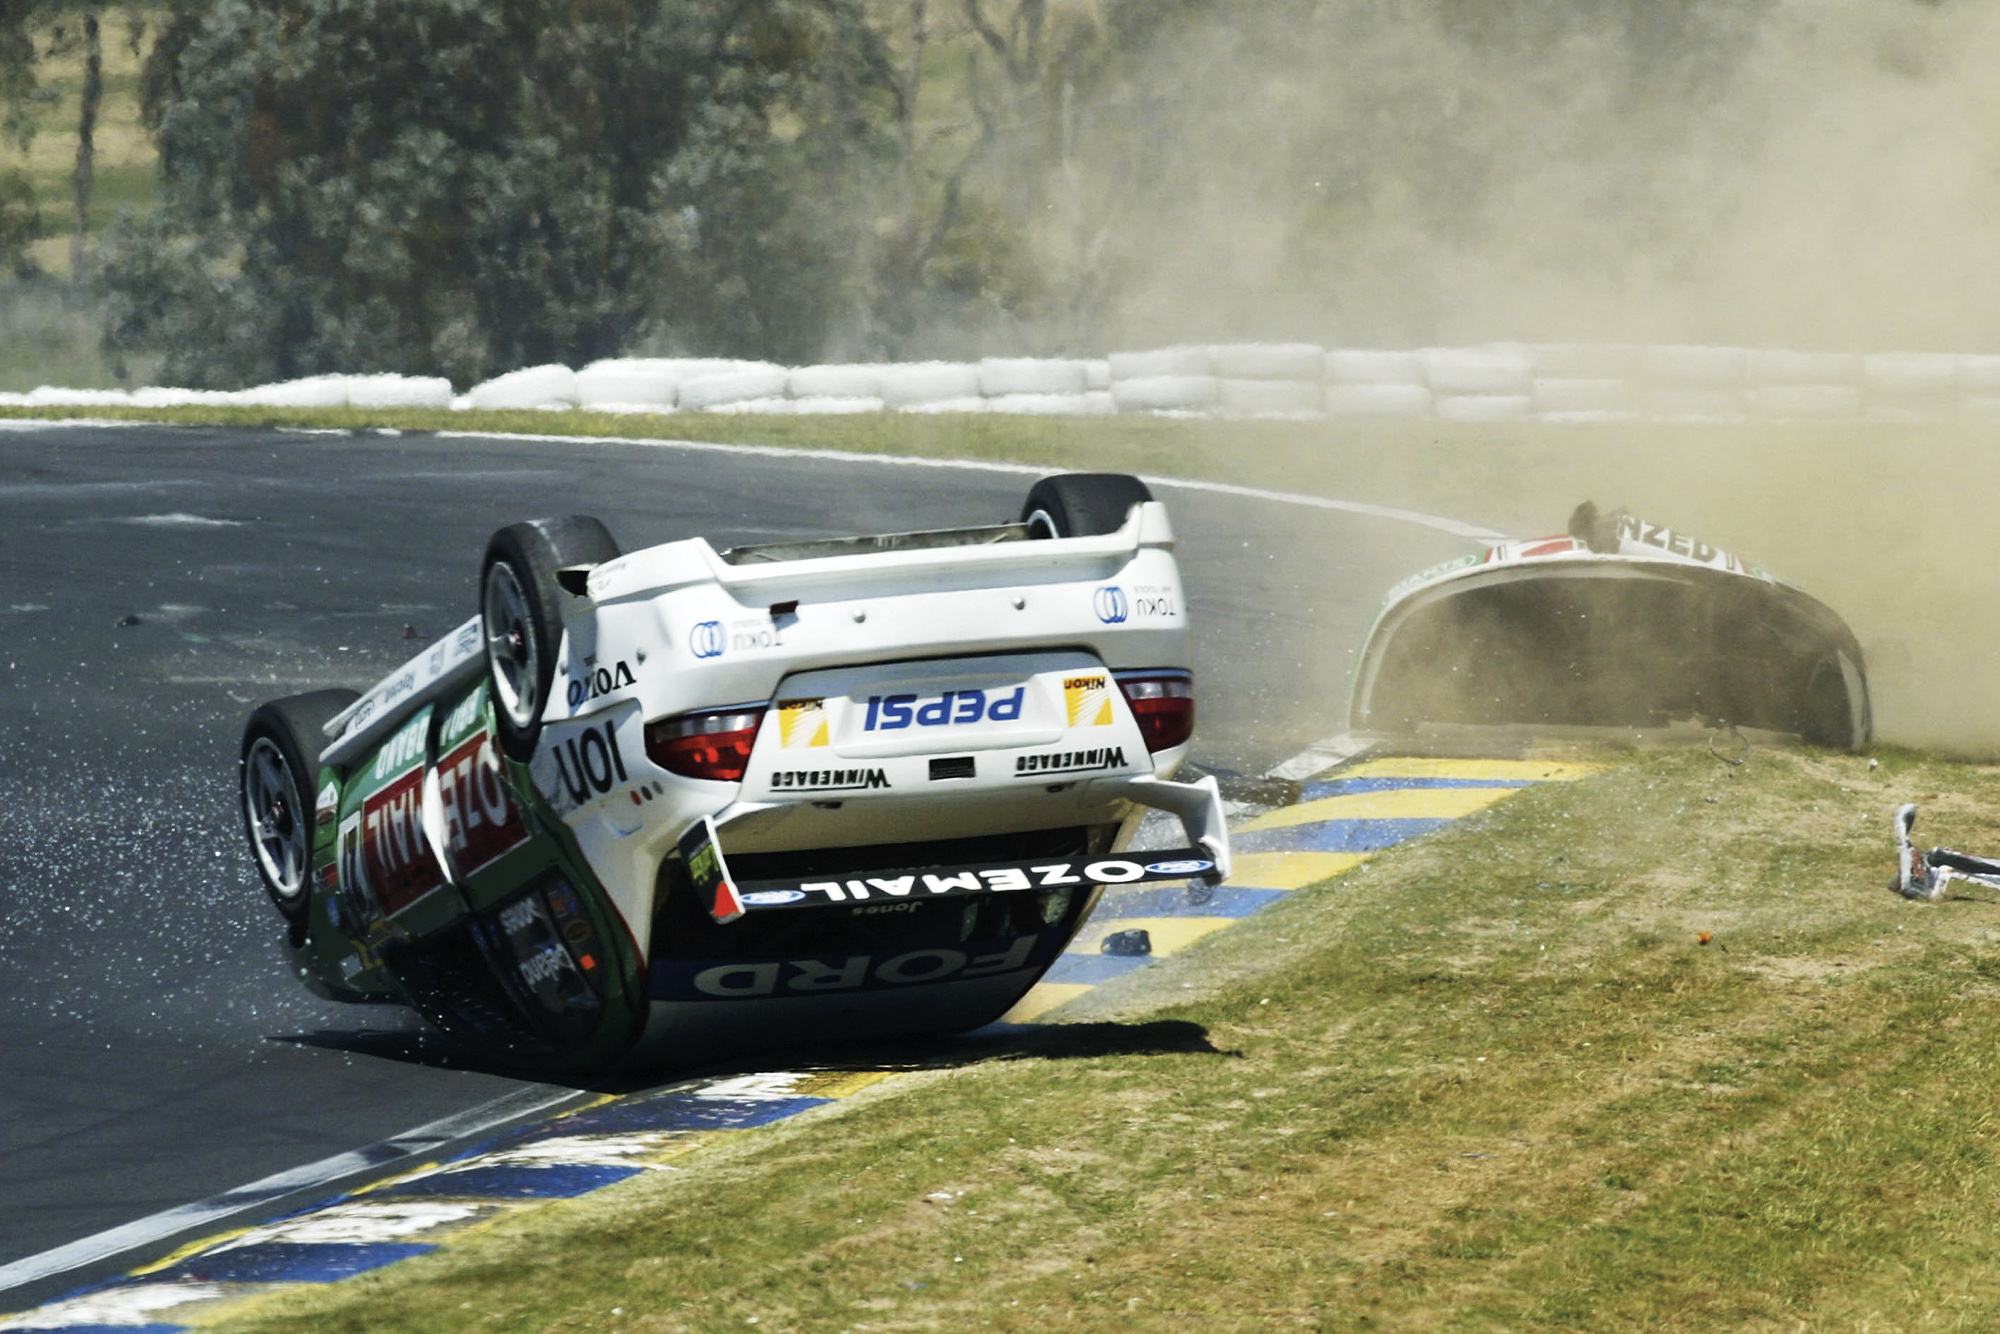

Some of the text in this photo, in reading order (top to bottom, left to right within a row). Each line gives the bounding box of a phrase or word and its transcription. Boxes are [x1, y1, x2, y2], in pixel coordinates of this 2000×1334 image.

[1617, 514, 1715, 561] NZED
[1137, 598, 1176, 617] TOKU
[1064, 676, 1105, 690] Nikon
[865, 688, 1025, 732] PEPSI
[800, 860, 1145, 902] OZEMAIL
[853, 900, 923, 916] Jones
[694, 935, 1036, 997] FORD
